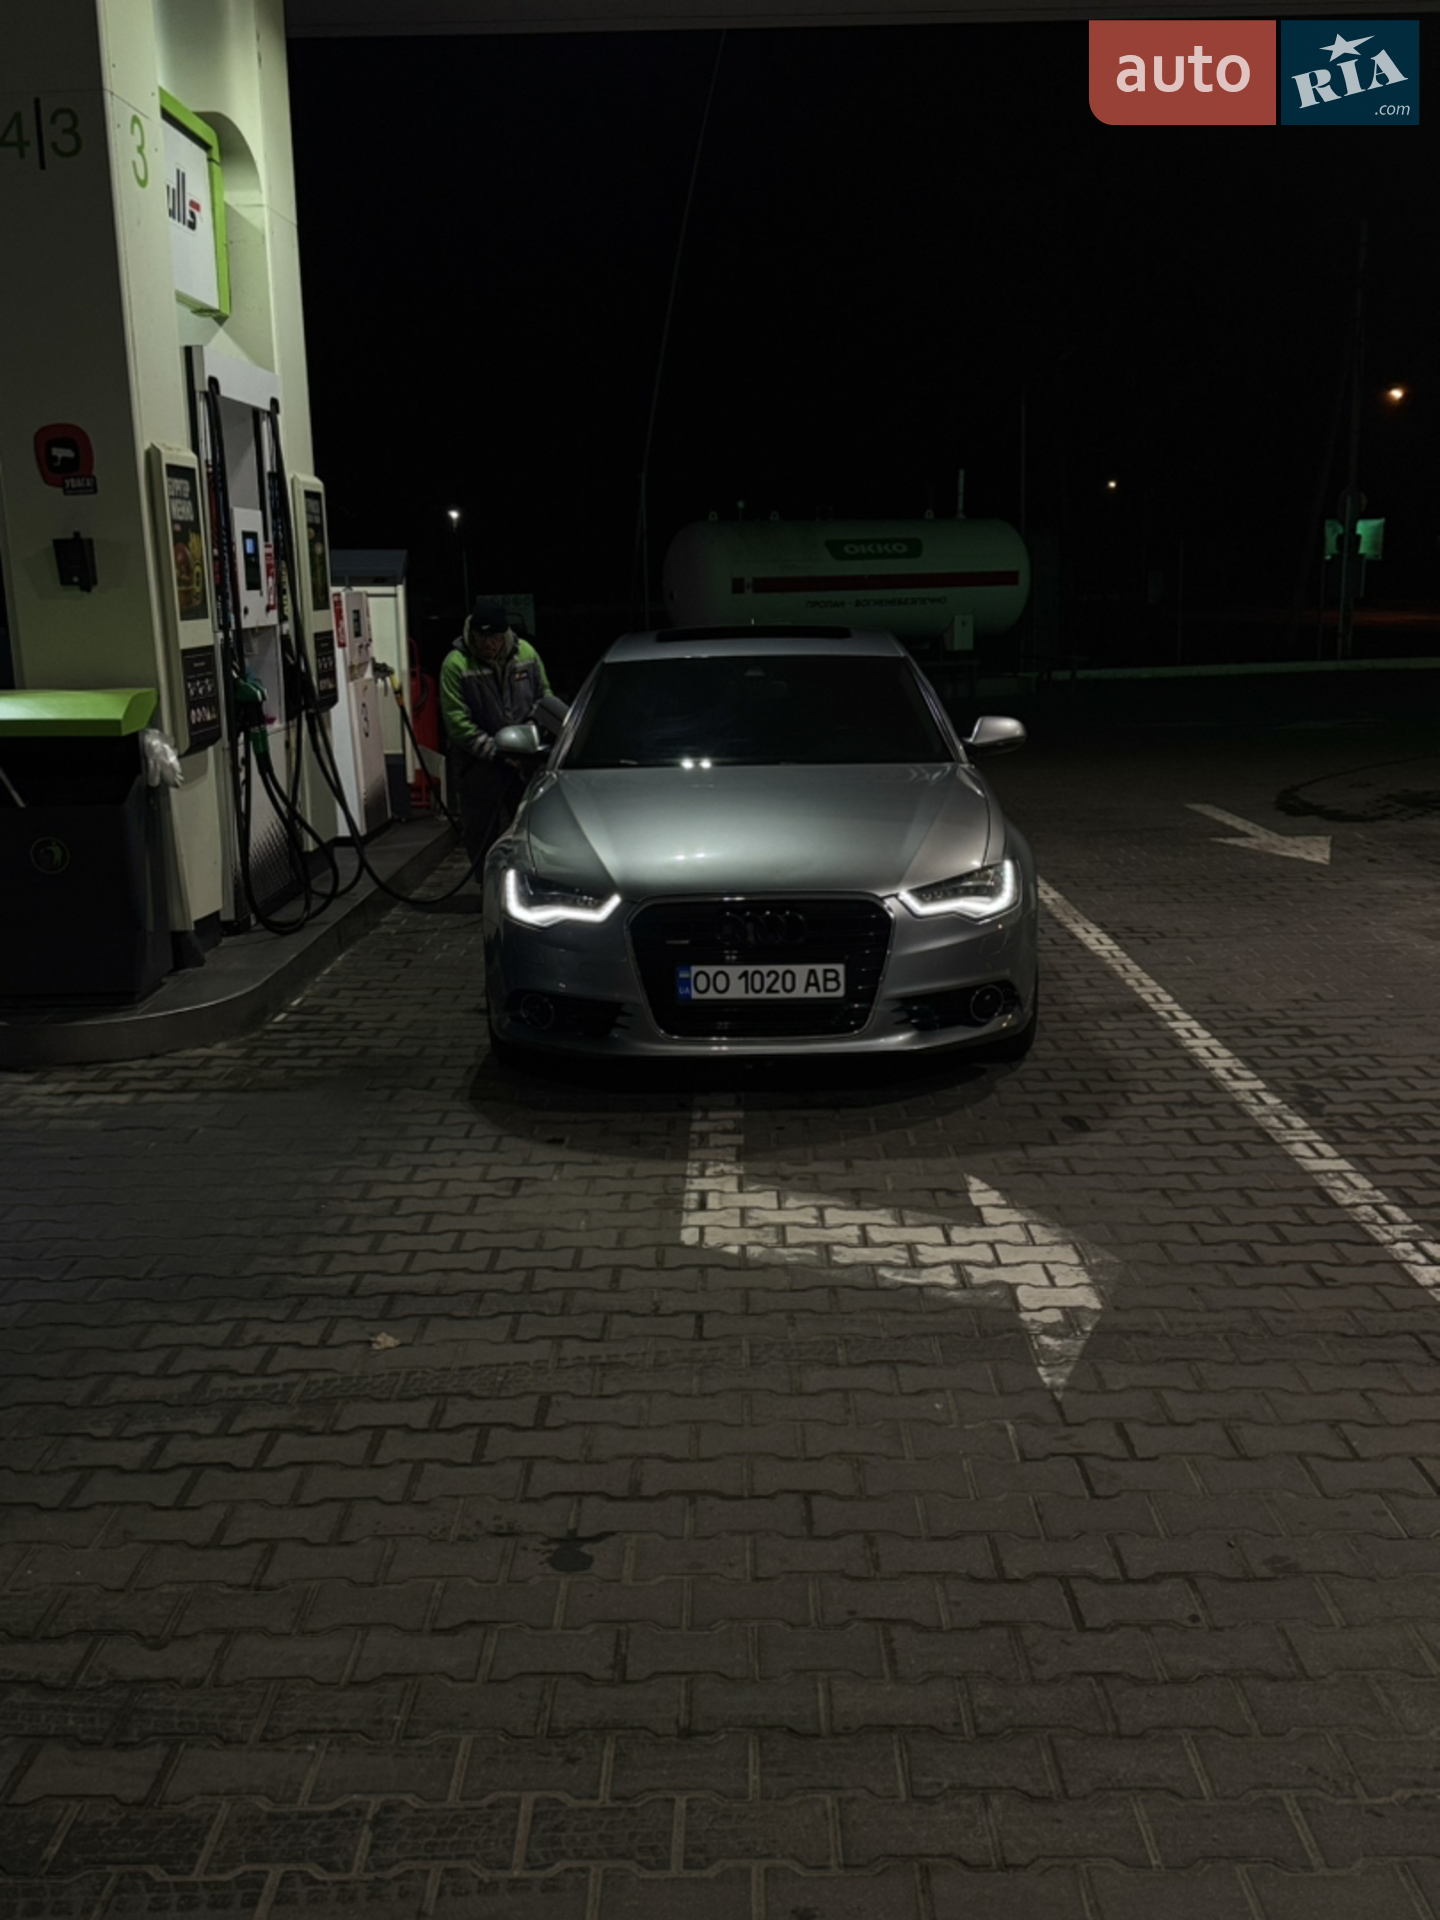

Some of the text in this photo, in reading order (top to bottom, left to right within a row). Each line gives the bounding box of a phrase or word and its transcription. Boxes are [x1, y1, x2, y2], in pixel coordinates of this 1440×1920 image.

[130, 115, 149, 188] 3
[804, 599, 846, 610] ПРОПАН
[678, 985, 690, 995] UA
[738, 969, 796, 994] 1020
[804, 968, 841, 993] AB
